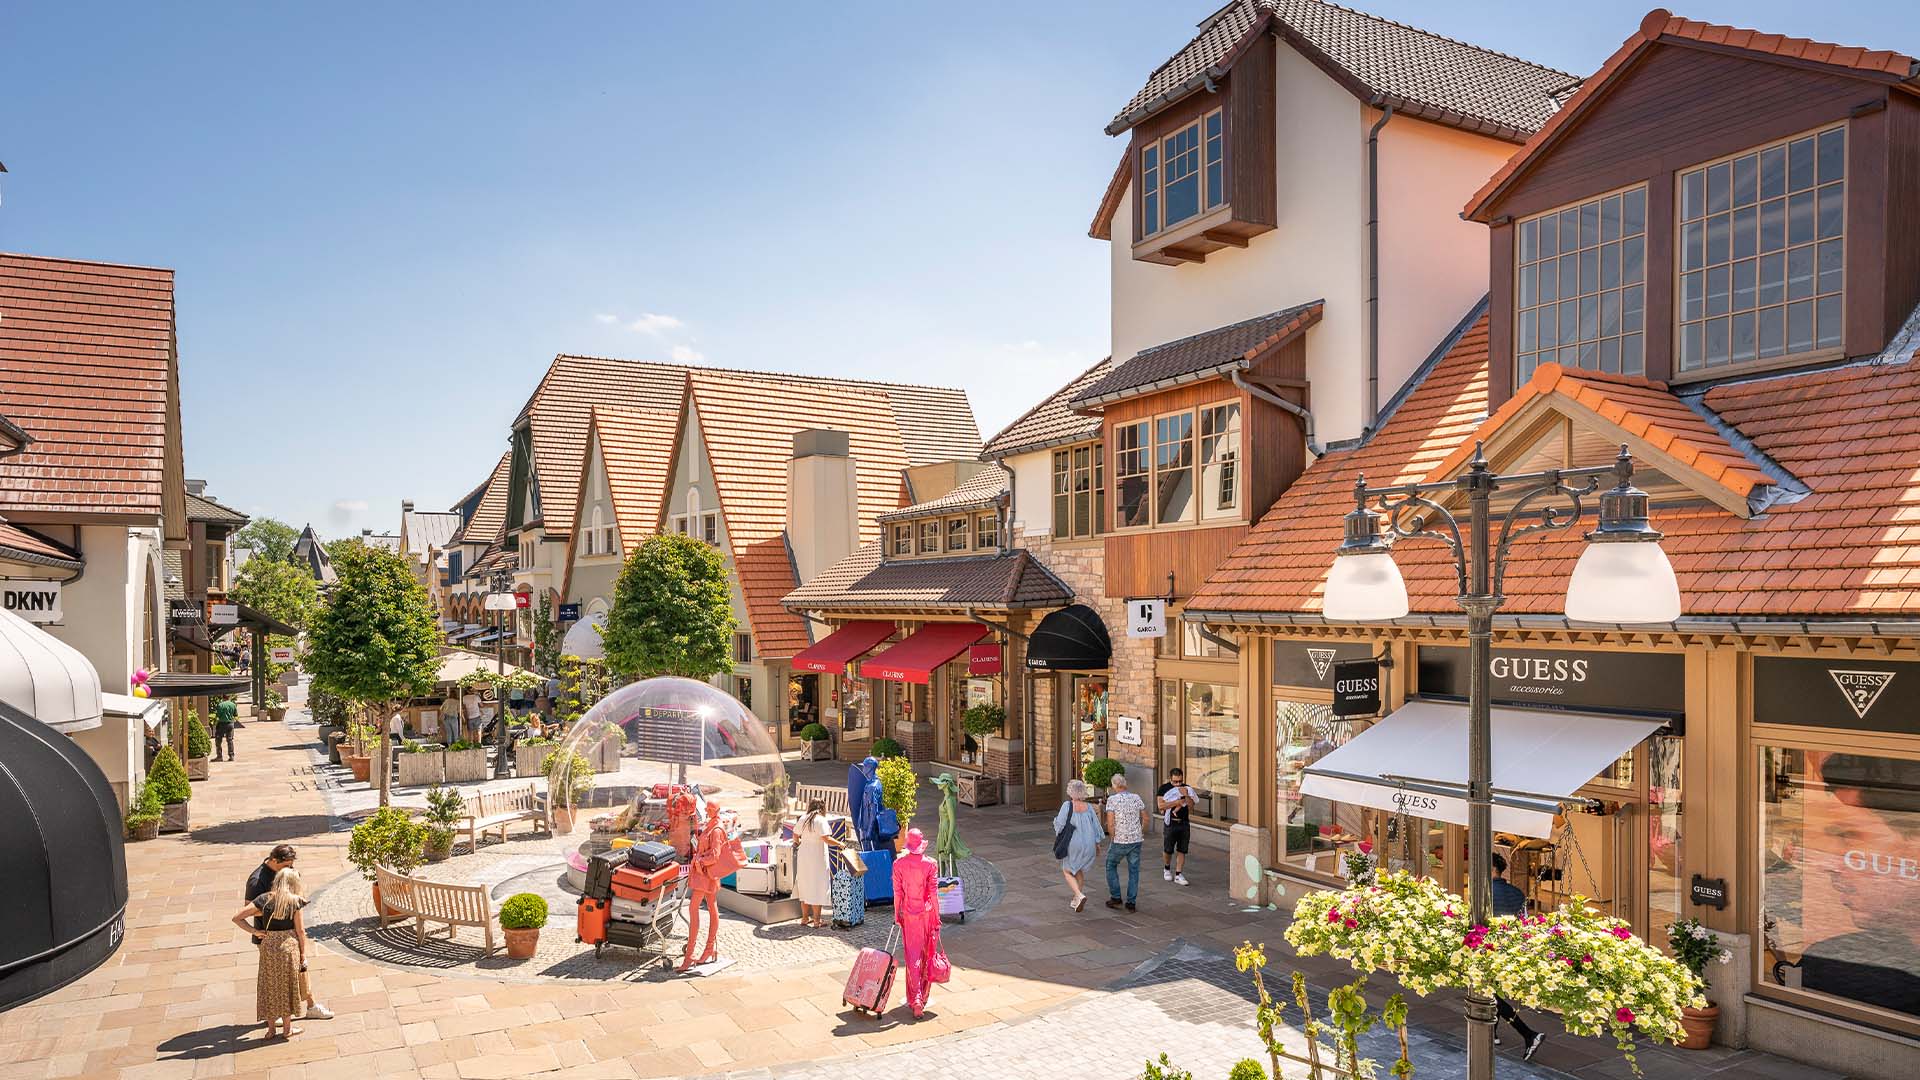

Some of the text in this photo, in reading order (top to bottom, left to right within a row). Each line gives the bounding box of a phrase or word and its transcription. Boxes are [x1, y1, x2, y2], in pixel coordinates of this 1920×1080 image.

[4, 591, 58, 611] DKNY
[1489, 657, 1588, 682] GUESS
[1336, 678, 1378, 694] GUESS
[1840, 674, 1884, 687] GUESS
[1510, 685, 1565, 696] accessories
[1392, 792, 1438, 810] GUESS
[1693, 885, 1722, 897] GUESS
